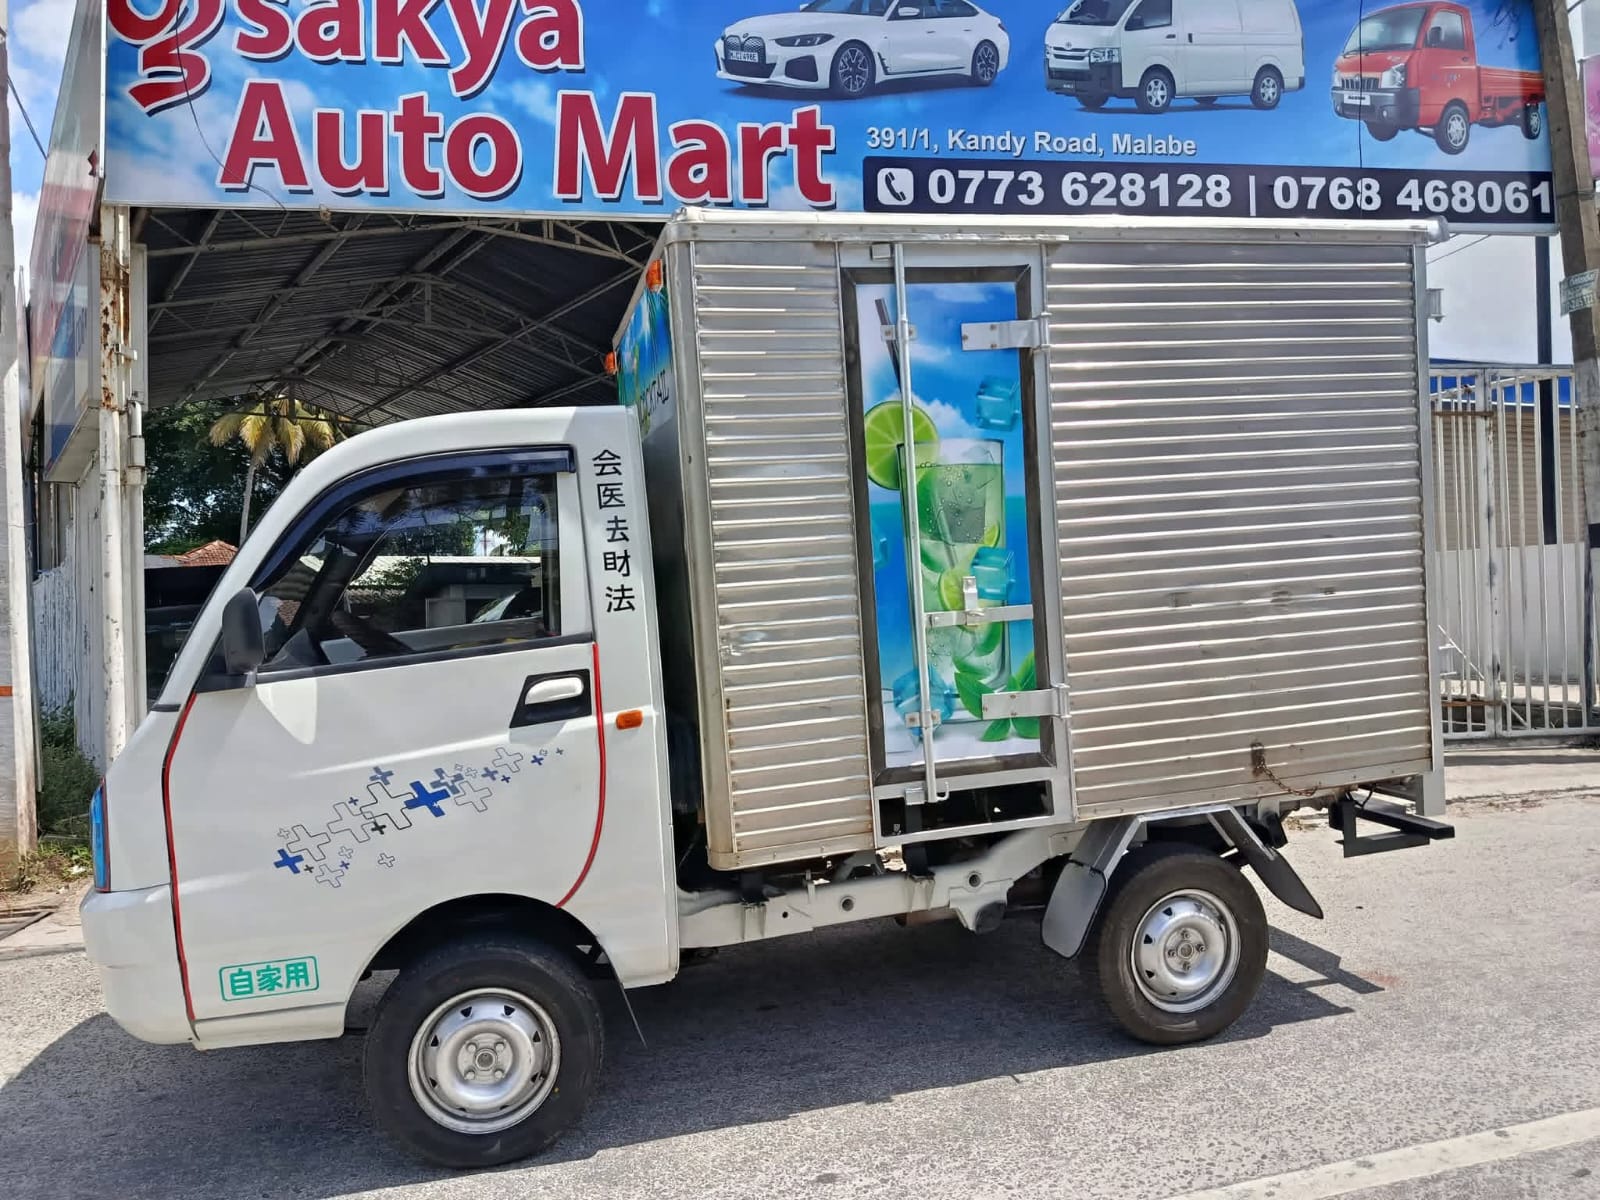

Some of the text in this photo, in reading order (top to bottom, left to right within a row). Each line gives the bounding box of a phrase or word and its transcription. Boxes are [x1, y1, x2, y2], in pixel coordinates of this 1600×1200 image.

[216, 80, 838, 204] Auto Mart
[866, 126, 1198, 157] 391/1, Kandy Road, Malabe
[928, 168, 1046, 206] 0773
[1061, 171, 1232, 209] 628128
[1273, 174, 1382, 212] 0768
[1396, 178, 1551, 214] 468061
[230, 961, 310, 996] 自家用
